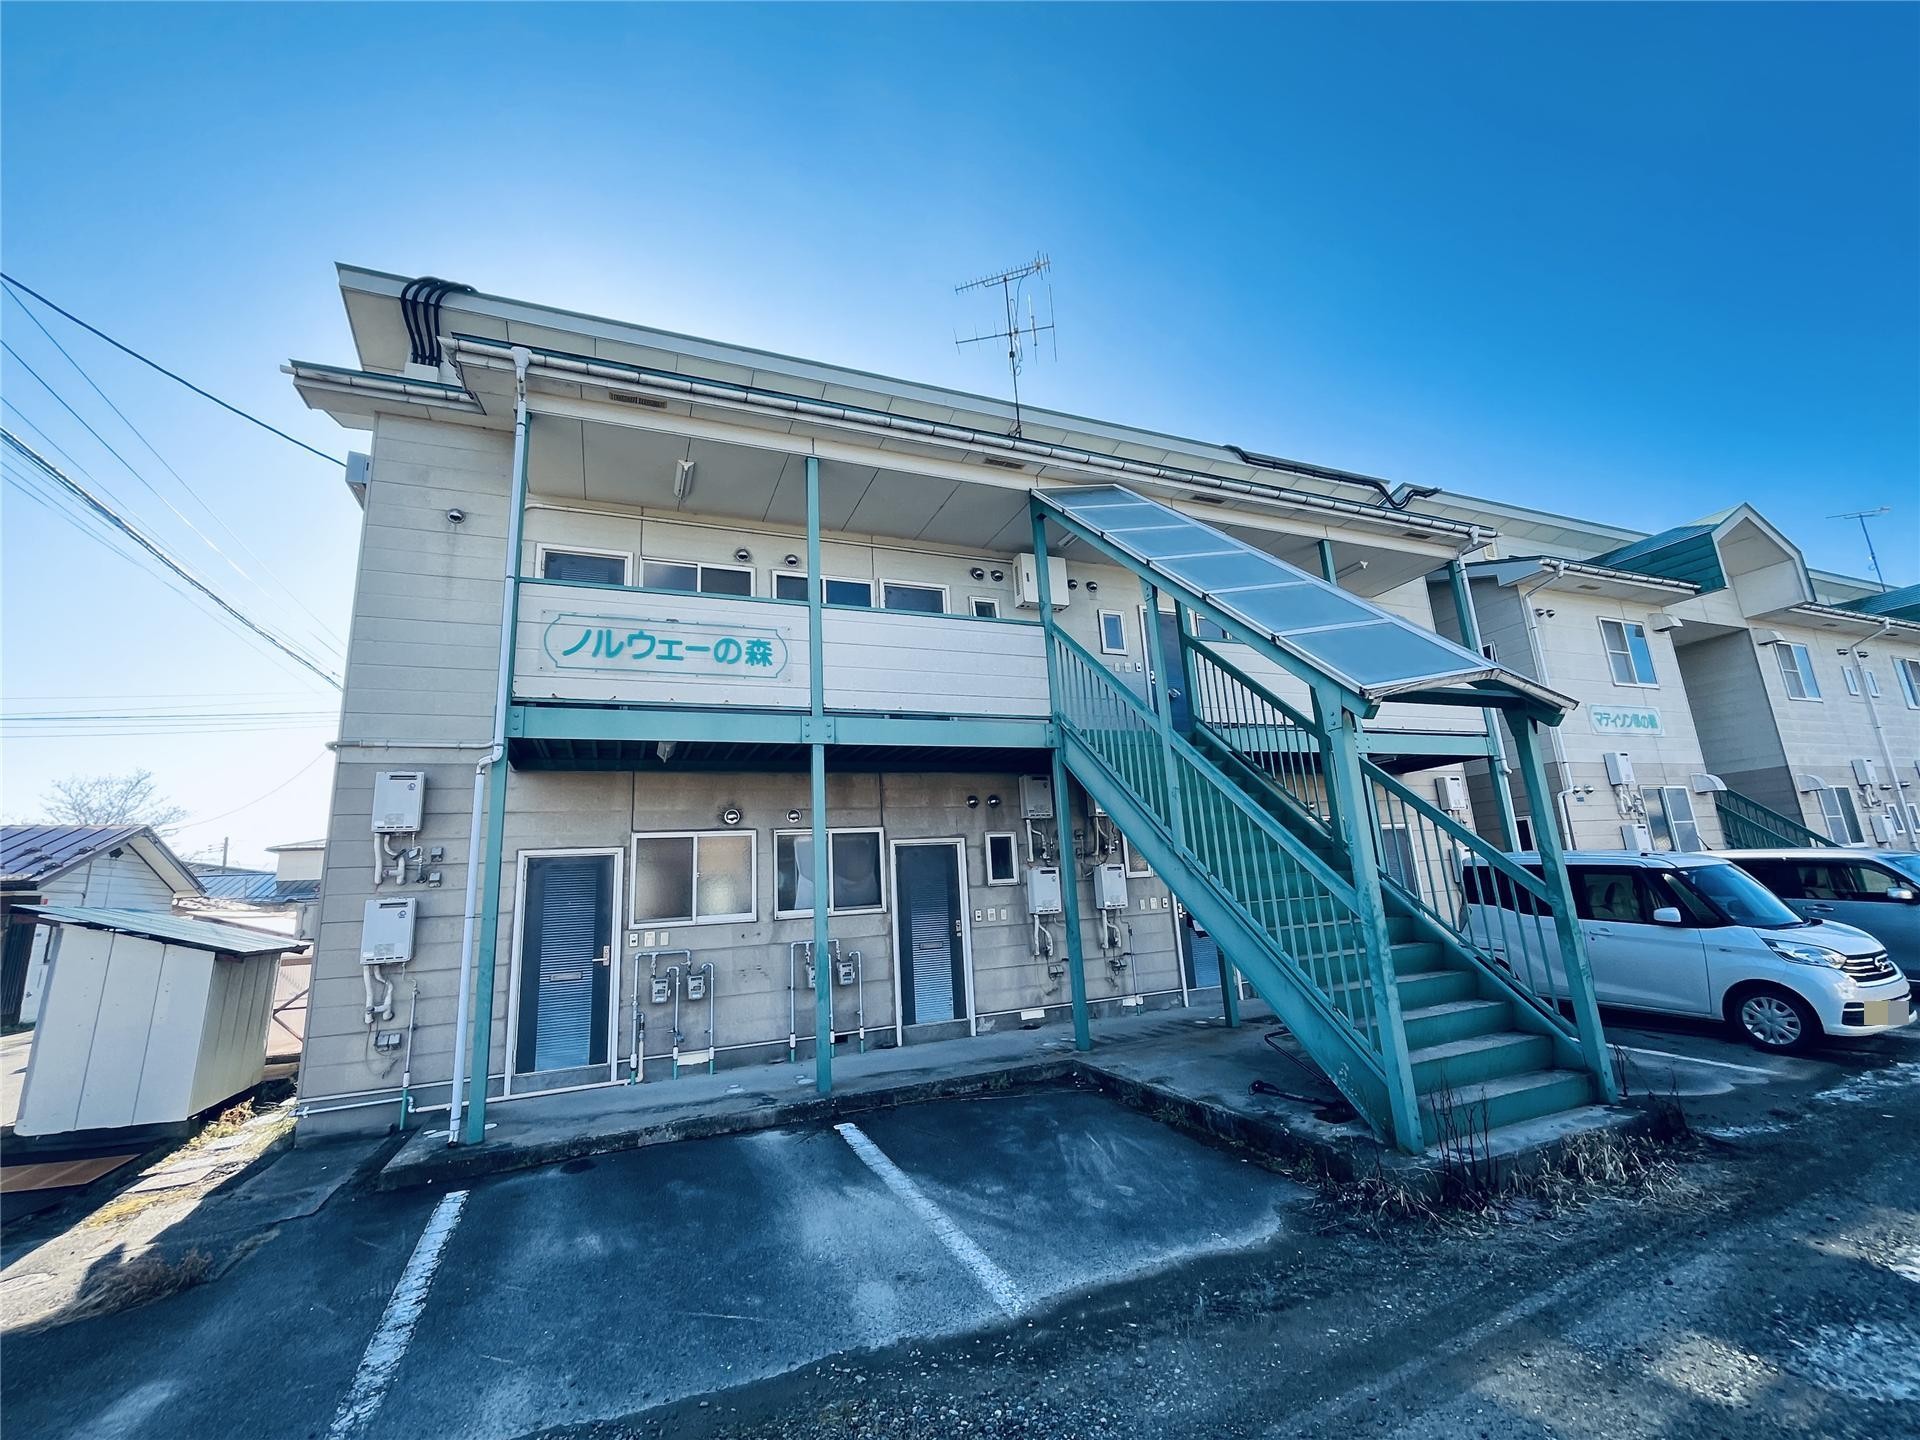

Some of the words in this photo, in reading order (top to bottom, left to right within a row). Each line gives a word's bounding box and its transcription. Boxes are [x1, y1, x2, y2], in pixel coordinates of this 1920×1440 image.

[562, 629, 773, 667] ノルウェーの森
